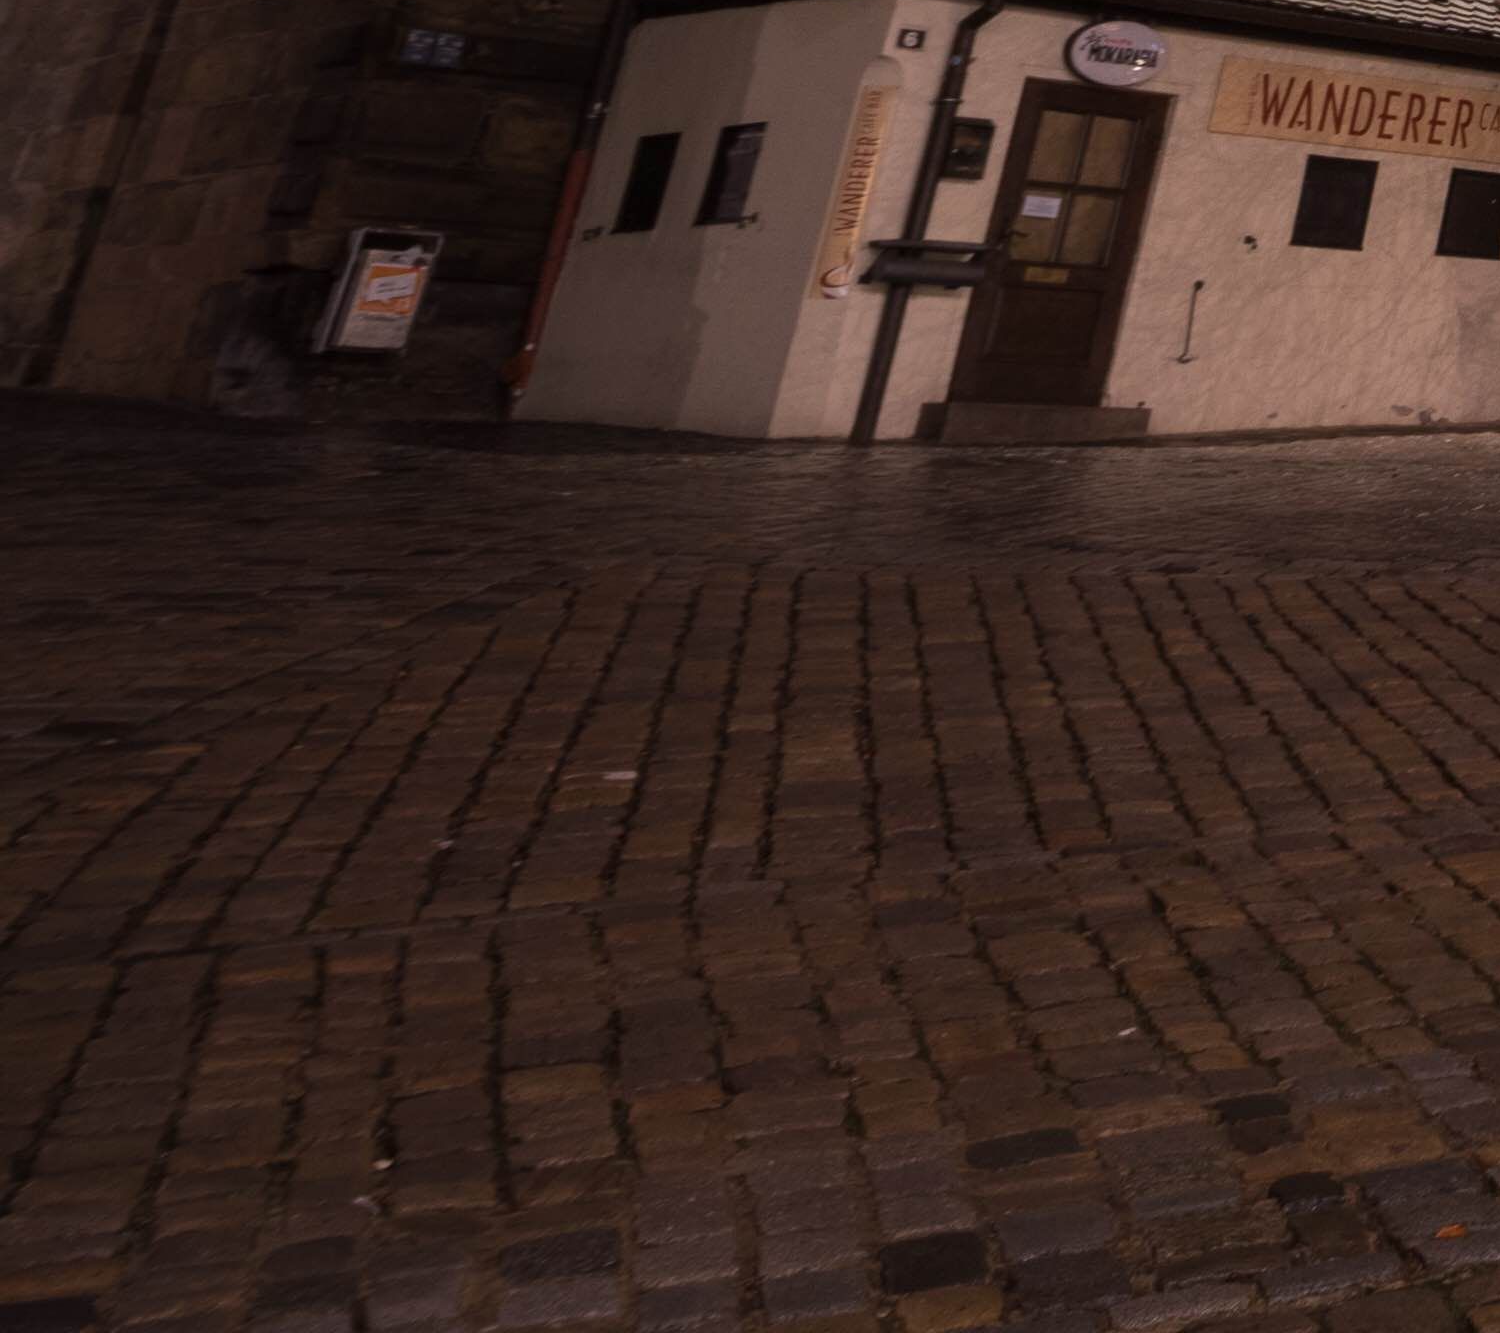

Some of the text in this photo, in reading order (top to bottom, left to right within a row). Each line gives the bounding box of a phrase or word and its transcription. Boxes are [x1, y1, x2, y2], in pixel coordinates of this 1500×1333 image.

[904, 32, 919, 48] 6
[1261, 73, 1474, 149] WANDERER
[833, 136, 882, 231] WANDERER
